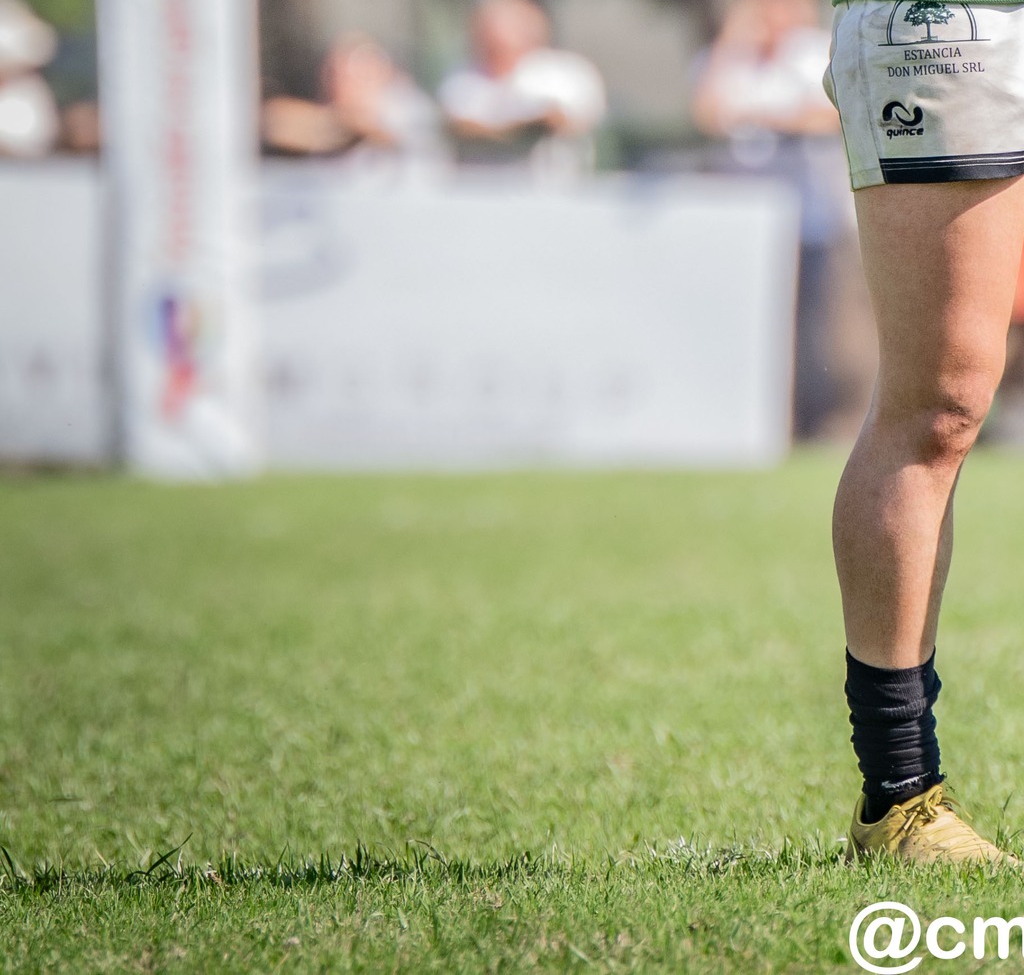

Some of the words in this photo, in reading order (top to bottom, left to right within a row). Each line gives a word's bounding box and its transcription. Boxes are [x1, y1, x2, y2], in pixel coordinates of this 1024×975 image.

[904, 47, 962, 61] ESTANCIA
[887, 65, 910, 78] DON
[913, 63, 959, 77] MIGUEL
[962, 61, 985, 73] SRL
[886, 126, 924, 139] quince
